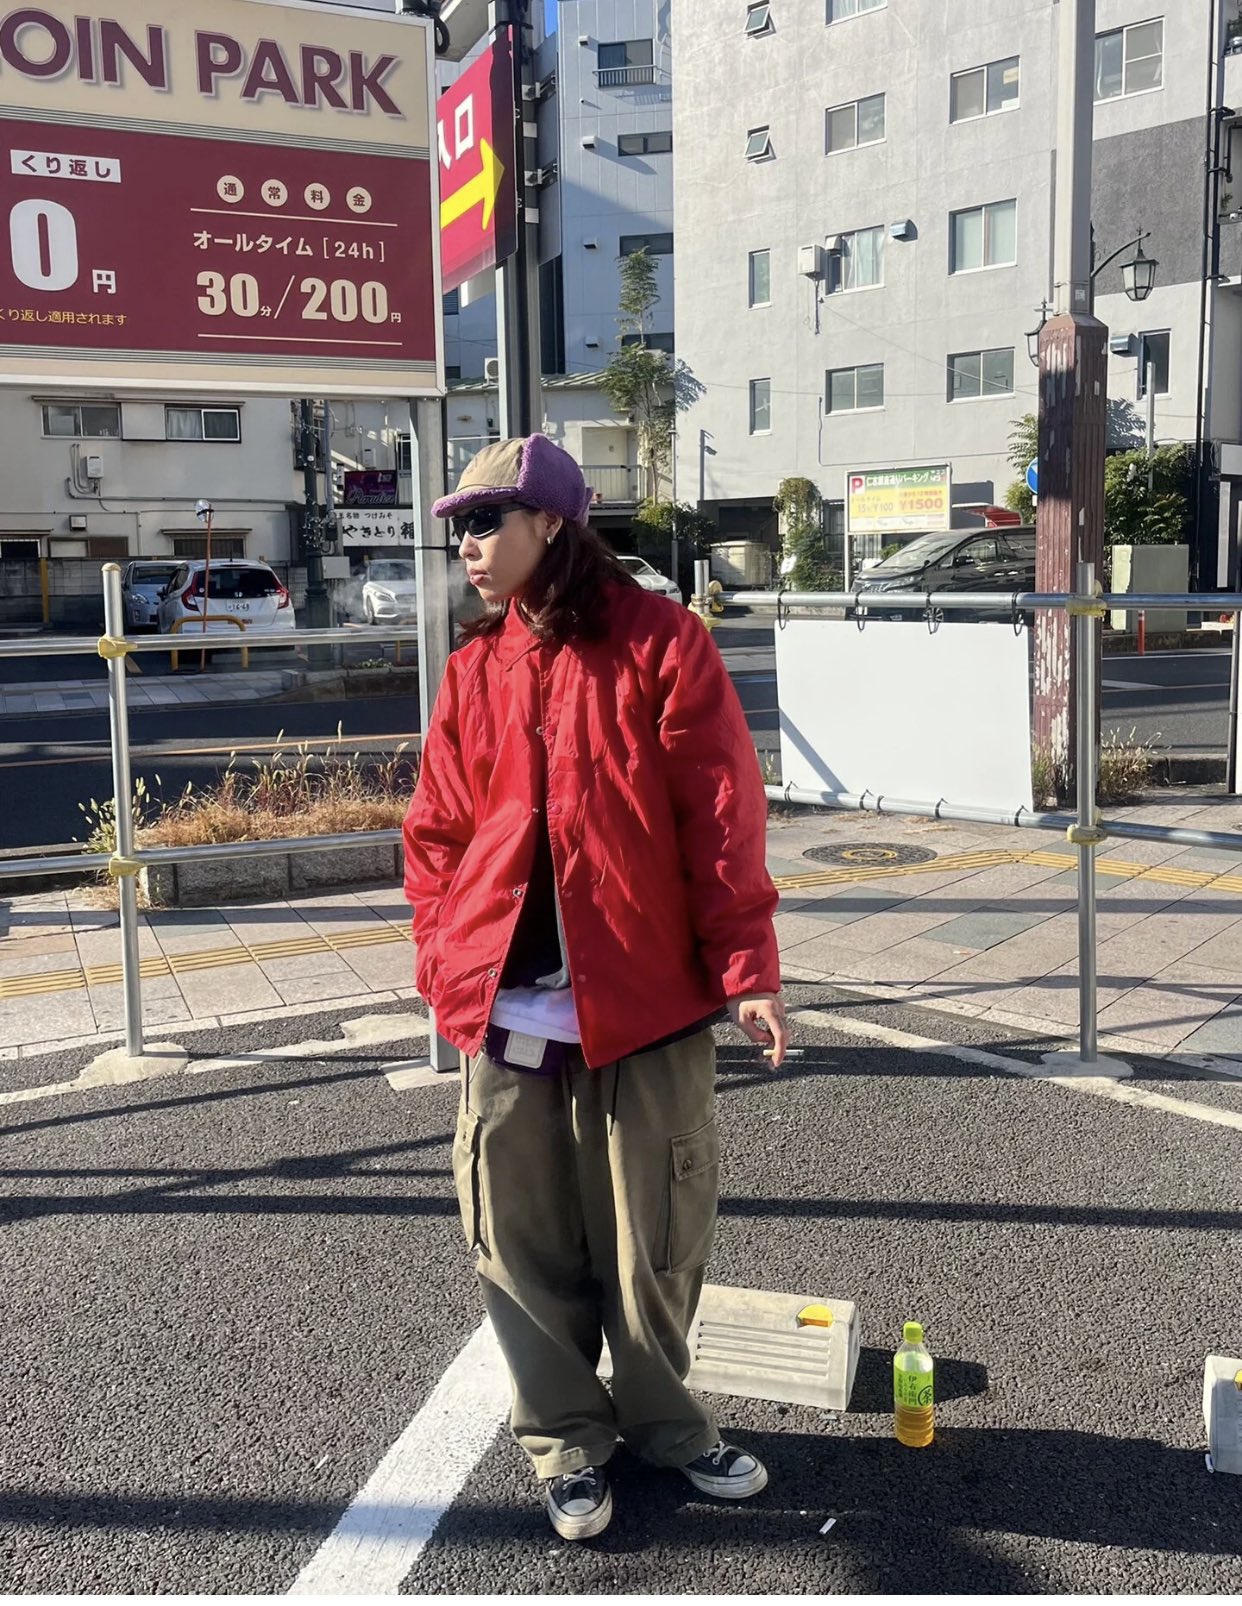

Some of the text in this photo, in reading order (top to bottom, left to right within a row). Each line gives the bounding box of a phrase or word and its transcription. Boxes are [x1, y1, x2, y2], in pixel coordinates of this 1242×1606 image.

[194, 30, 402, 117] PARK
[21, 155, 112, 179] くり返し
[220, 179, 370, 210] 通常料金
[851, 477, 863, 494] P
